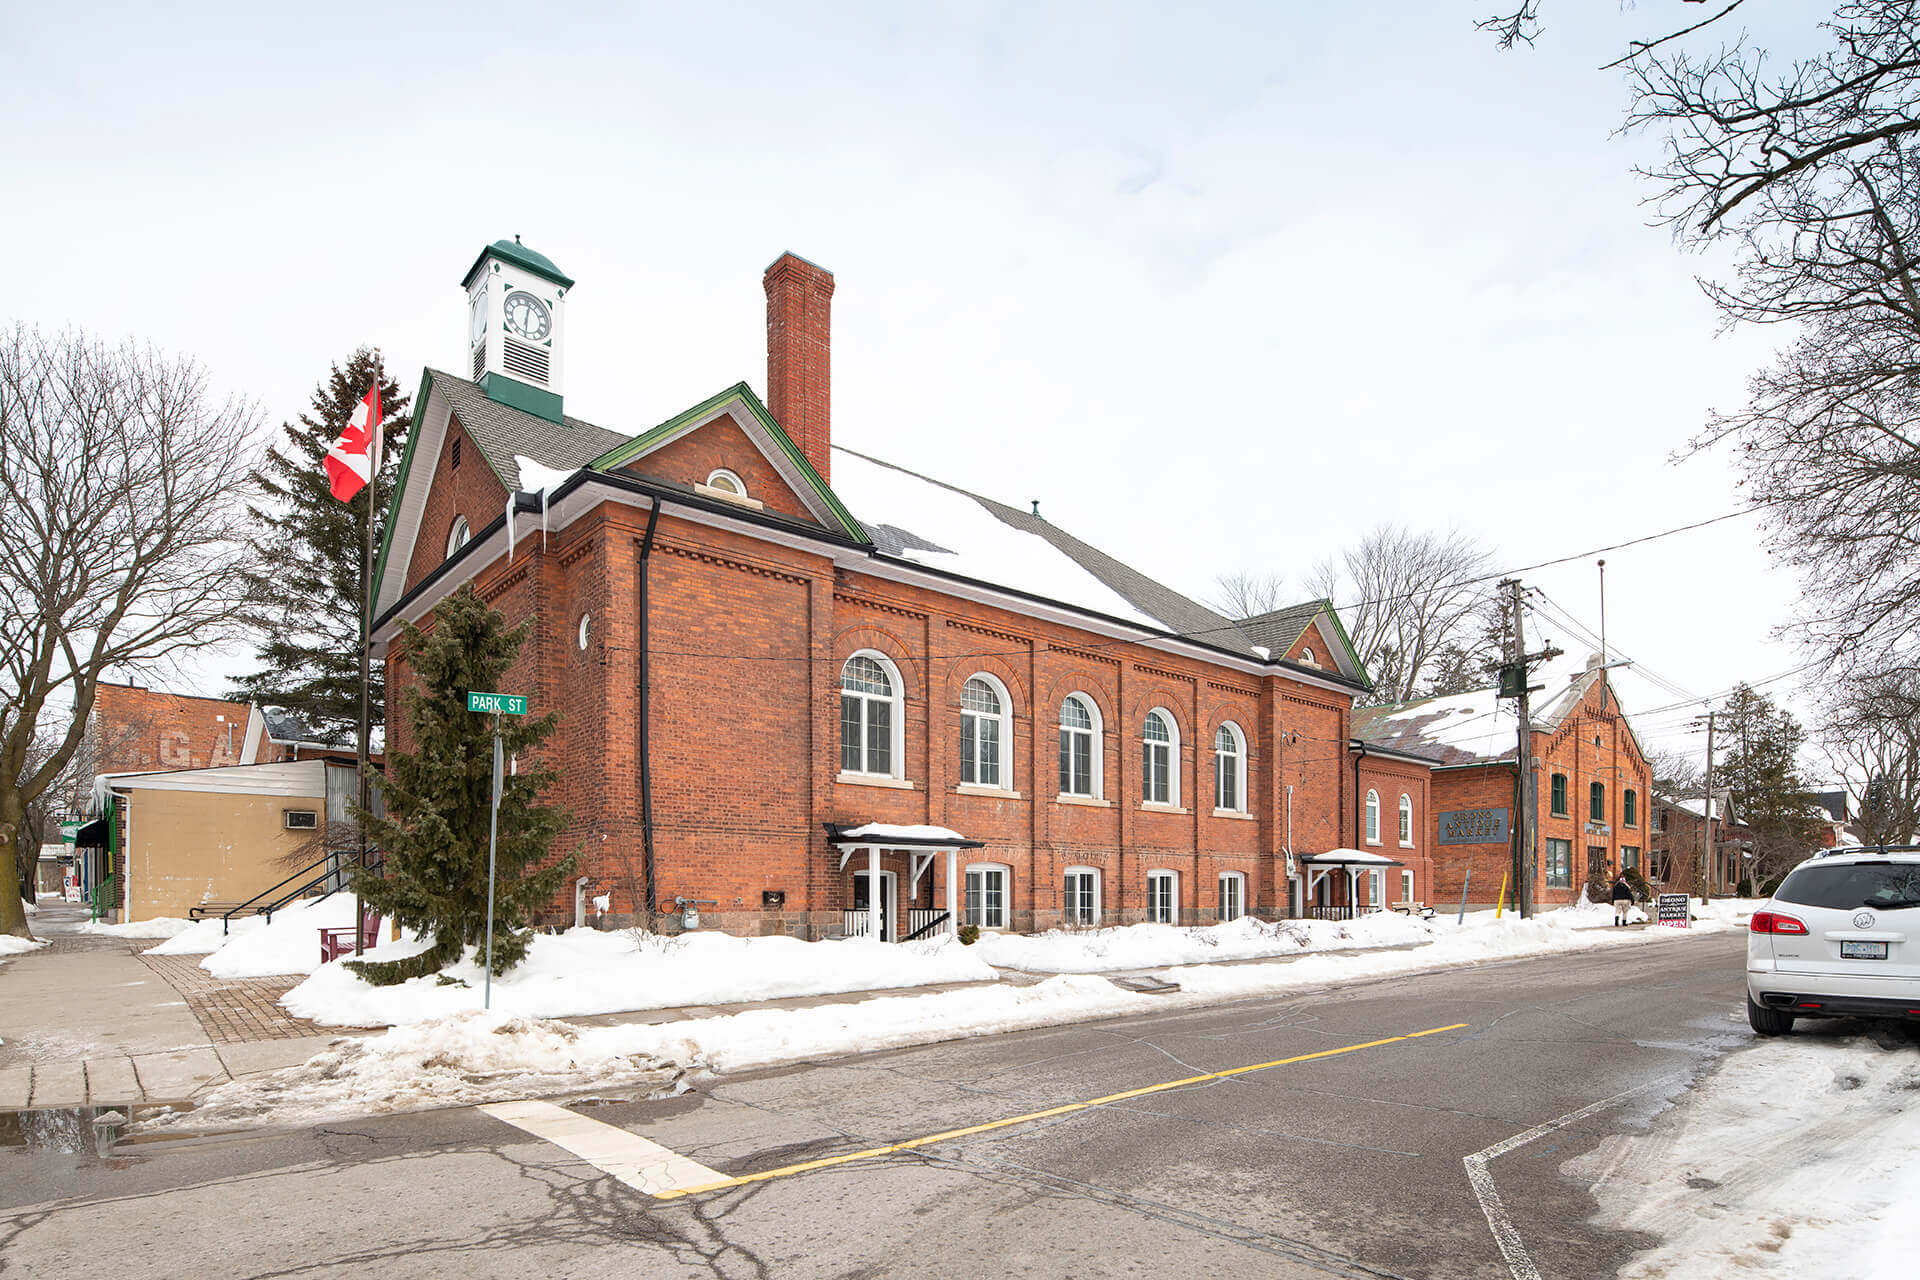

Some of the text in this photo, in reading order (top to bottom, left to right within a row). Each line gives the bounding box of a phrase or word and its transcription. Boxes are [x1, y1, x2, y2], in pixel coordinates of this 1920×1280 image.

[472, 695, 522, 712] PARK ST
[1445, 819, 1501, 830] ANTIQUE
[1447, 828, 1497, 838] MARKET
[1659, 919, 1686, 928] OPEN
